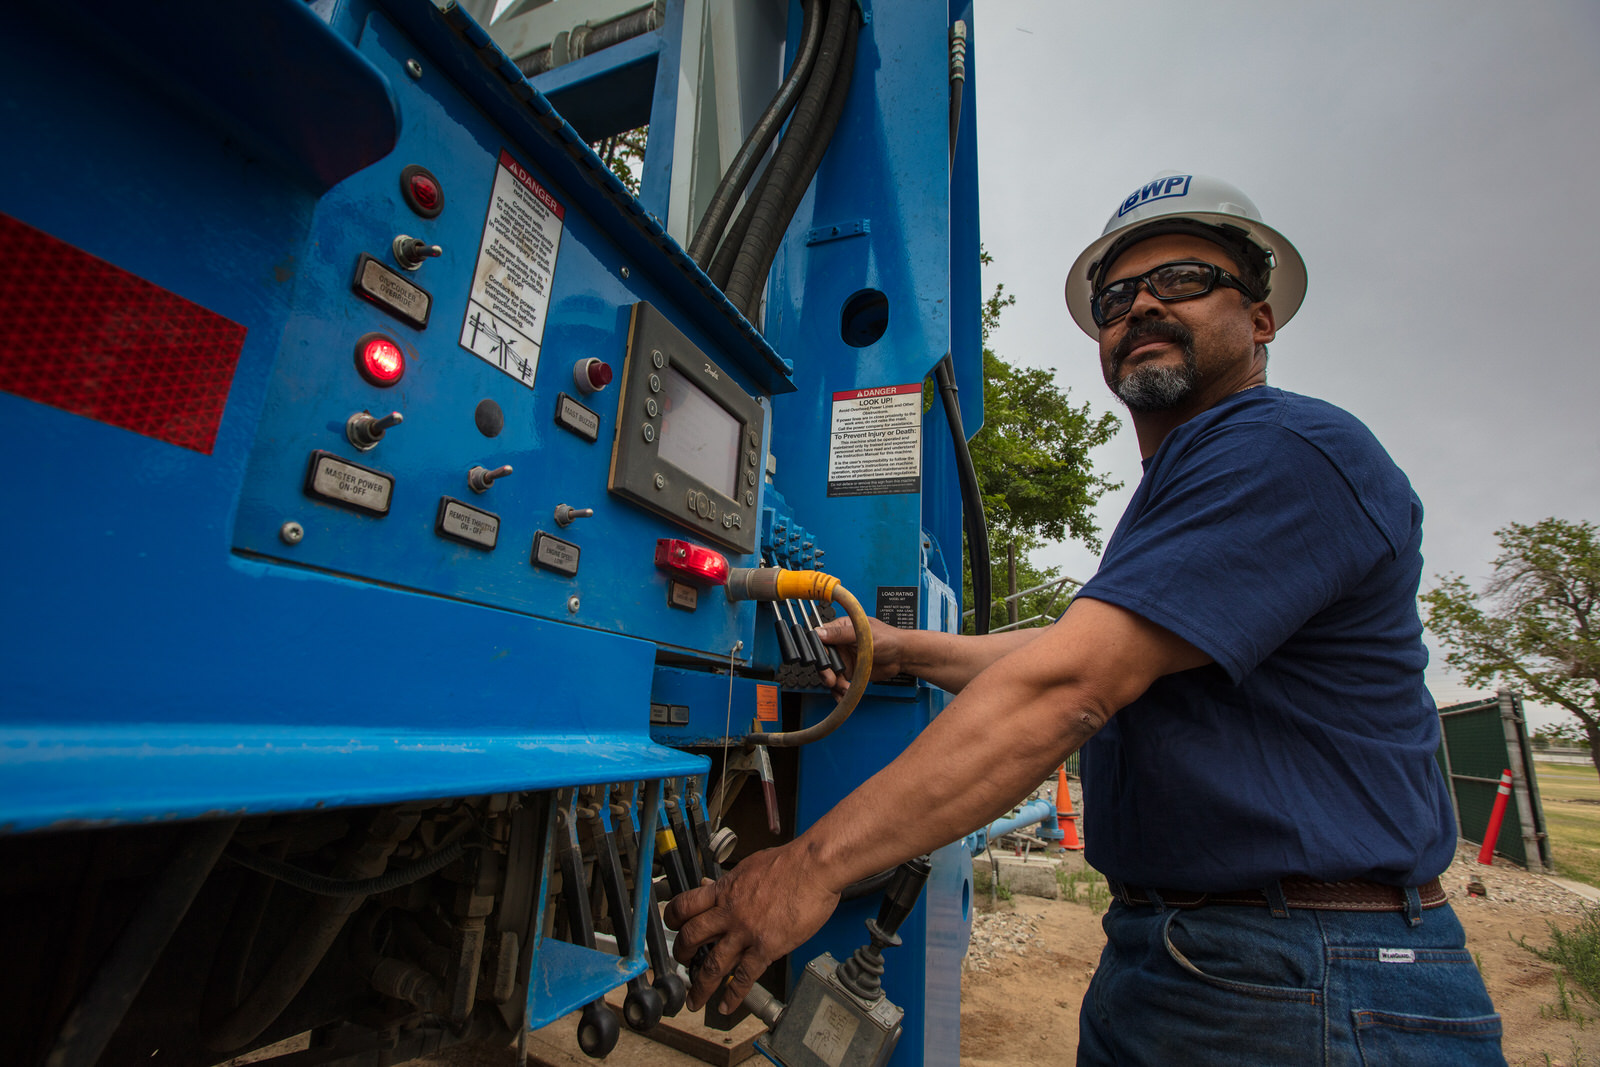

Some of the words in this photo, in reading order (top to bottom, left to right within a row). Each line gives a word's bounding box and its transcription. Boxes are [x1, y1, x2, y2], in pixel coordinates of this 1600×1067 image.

[513, 189, 522, 200] not
[513, 179, 523, 192] This
[524, 192, 544, 212] machine
[519, 170, 557, 212] DANGER
[500, 214, 511, 226] with
[512, 225, 522, 236] any
[522, 234, 532, 245] part
[503, 210, 524, 230] charged
[525, 228, 540, 243] power
[541, 241, 552, 254] lines
[504, 202, 517, 216] even
[518, 215, 531, 228] close
[532, 227, 554, 248] proximity
[513, 201, 532, 222] Contact
[533, 220, 543, 231] with
[494, 218, 510, 233] pump
[511, 231, 524, 246] hoist
[524, 242, 535, 254] may
[536, 253, 549, 266] result
[495, 226, 515, 245] serious
[516, 242, 530, 258] injury
[485, 249, 506, 267] desired
[506, 266, 521, 279] setup
[522, 278, 542, 295] position
[489, 245, 505, 259] close
[505, 257, 529, 279] proximity
[499, 244, 516, 259] power
[516, 257, 528, 270] lines
[529, 268, 537, 277] are
[380, 284, 412, 308] OVERRIDE
[488, 274, 510, 294] Contact
[511, 291, 519, 301] the
[520, 299, 536, 312] power
[507, 274, 524, 289] STOP!
[485, 281, 510, 303] company
[519, 305, 536, 321] further
[485, 288, 516, 315] instructions
[518, 312, 534, 327] before
[864, 388, 896, 396] DANGER
[565, 406, 578, 418] MAST
[325, 468, 356, 484] MASTER
[358, 478, 382, 492] POWER
[450, 510, 470, 523] REMOTE
